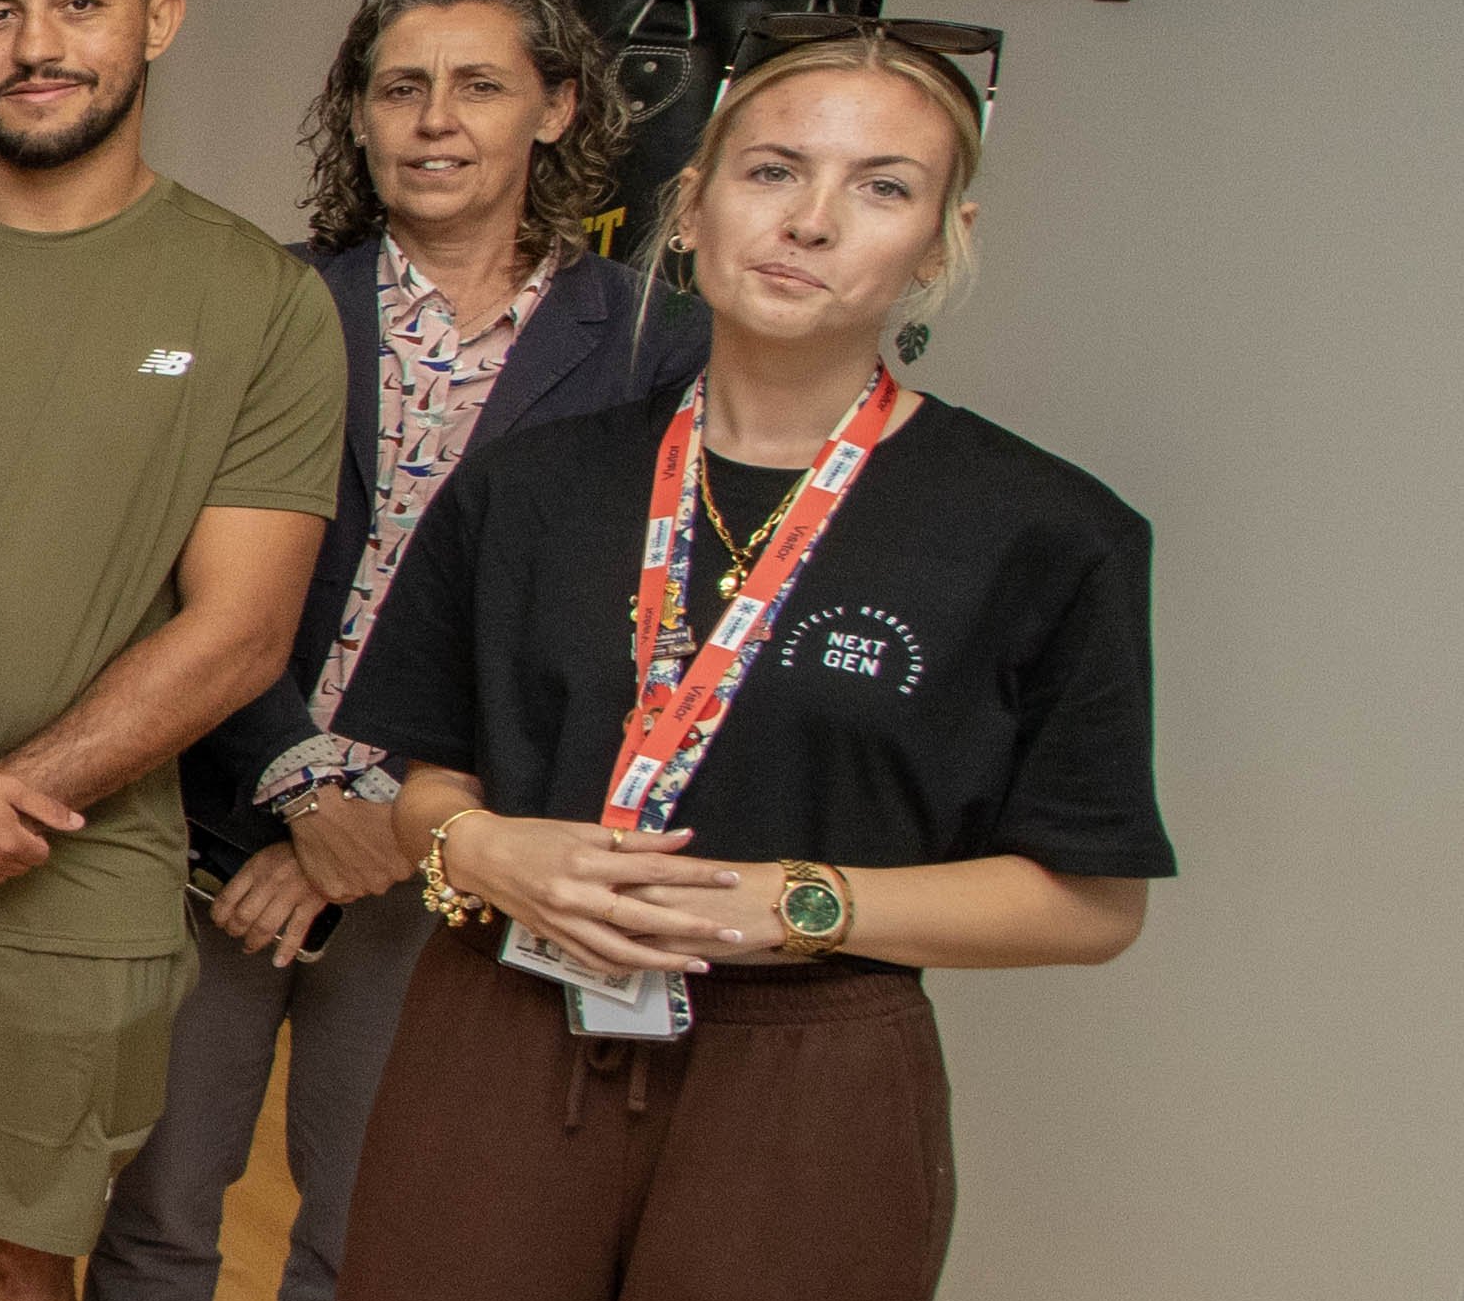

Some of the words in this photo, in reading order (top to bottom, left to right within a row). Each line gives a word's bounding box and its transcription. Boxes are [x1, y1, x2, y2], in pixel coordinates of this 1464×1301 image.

[776, 524, 809, 562] Visitor
[781, 605, 845, 667] POLITELY
[860, 605, 924, 695] REBELLIOUS
[826, 631, 889, 656] NEXT
[821, 649, 881, 677] GEN
[673, 684, 707, 723] Visitor
